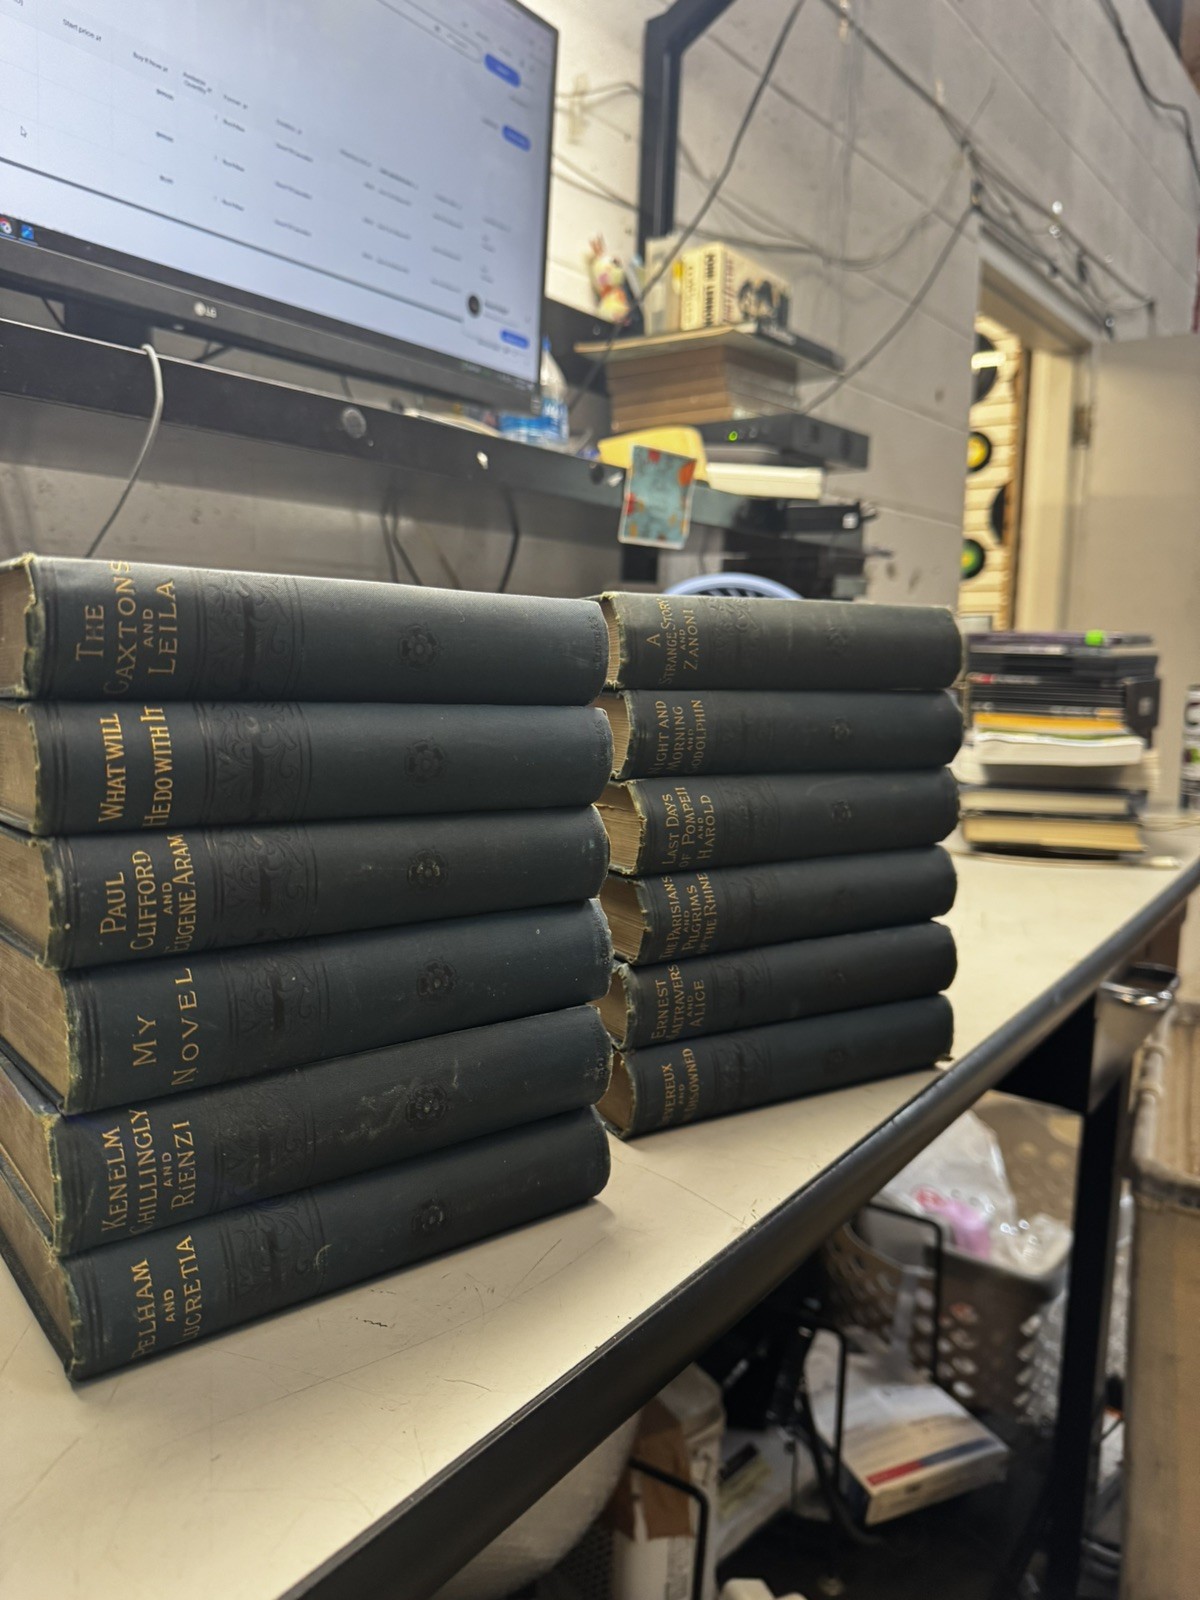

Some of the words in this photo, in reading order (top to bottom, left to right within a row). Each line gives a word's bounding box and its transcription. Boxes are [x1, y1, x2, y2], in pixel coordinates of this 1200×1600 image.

[75, 604, 105, 661] THE
[103, 560, 137, 694] CAXTONS
[142, 608, 154, 648] AND
[147, 579, 178, 675] LEILA
[646, 633, 662, 648] A
[679, 629, 687, 651] AND
[682, 609, 700, 671] ZANONI
[659, 631, 678, 684] STRANGE
[99, 712, 125, 761] WILL
[140, 705, 166, 722] IT
[655, 700, 670, 729] AND
[665, 706, 686, 771] MORNING
[687, 728, 695, 751] AND
[148, 726, 173, 775] WITH
[647, 732, 670, 775] NIGHT
[98, 763, 127, 823] WHAT
[662, 793, 680, 828] DAYS
[675, 786, 696, 846] POMPEII
[662, 833, 680, 865] LAST
[697, 794, 716, 859] HAROLD
[166, 833, 196, 887] ARAM
[100, 871, 127, 934] PAUL
[129, 850, 157, 950] CLIFFORD
[161, 882, 174, 915] AND
[164, 889, 197, 953] EUGENE
[661, 875, 682, 941] PARISIANS
[682, 885, 702, 951] PILGRIMS
[696, 872, 717, 917] RHINE
[170, 967, 199, 1086] NOVEL
[651, 979, 669, 1040] ERNEST
[689, 980, 706, 1027] ALICE
[132, 1014, 158, 1067] MY
[101, 1125, 128, 1232] KENELM
[128, 1109, 158, 1235] CHILLINGLY
[161, 1151, 174, 1188] AND
[171, 1120, 196, 1210] RIENZI
[130, 1257, 156, 1360] PELHAM
[162, 1288, 176, 1322] AND
[175, 1234, 203, 1339] UCRETIA
